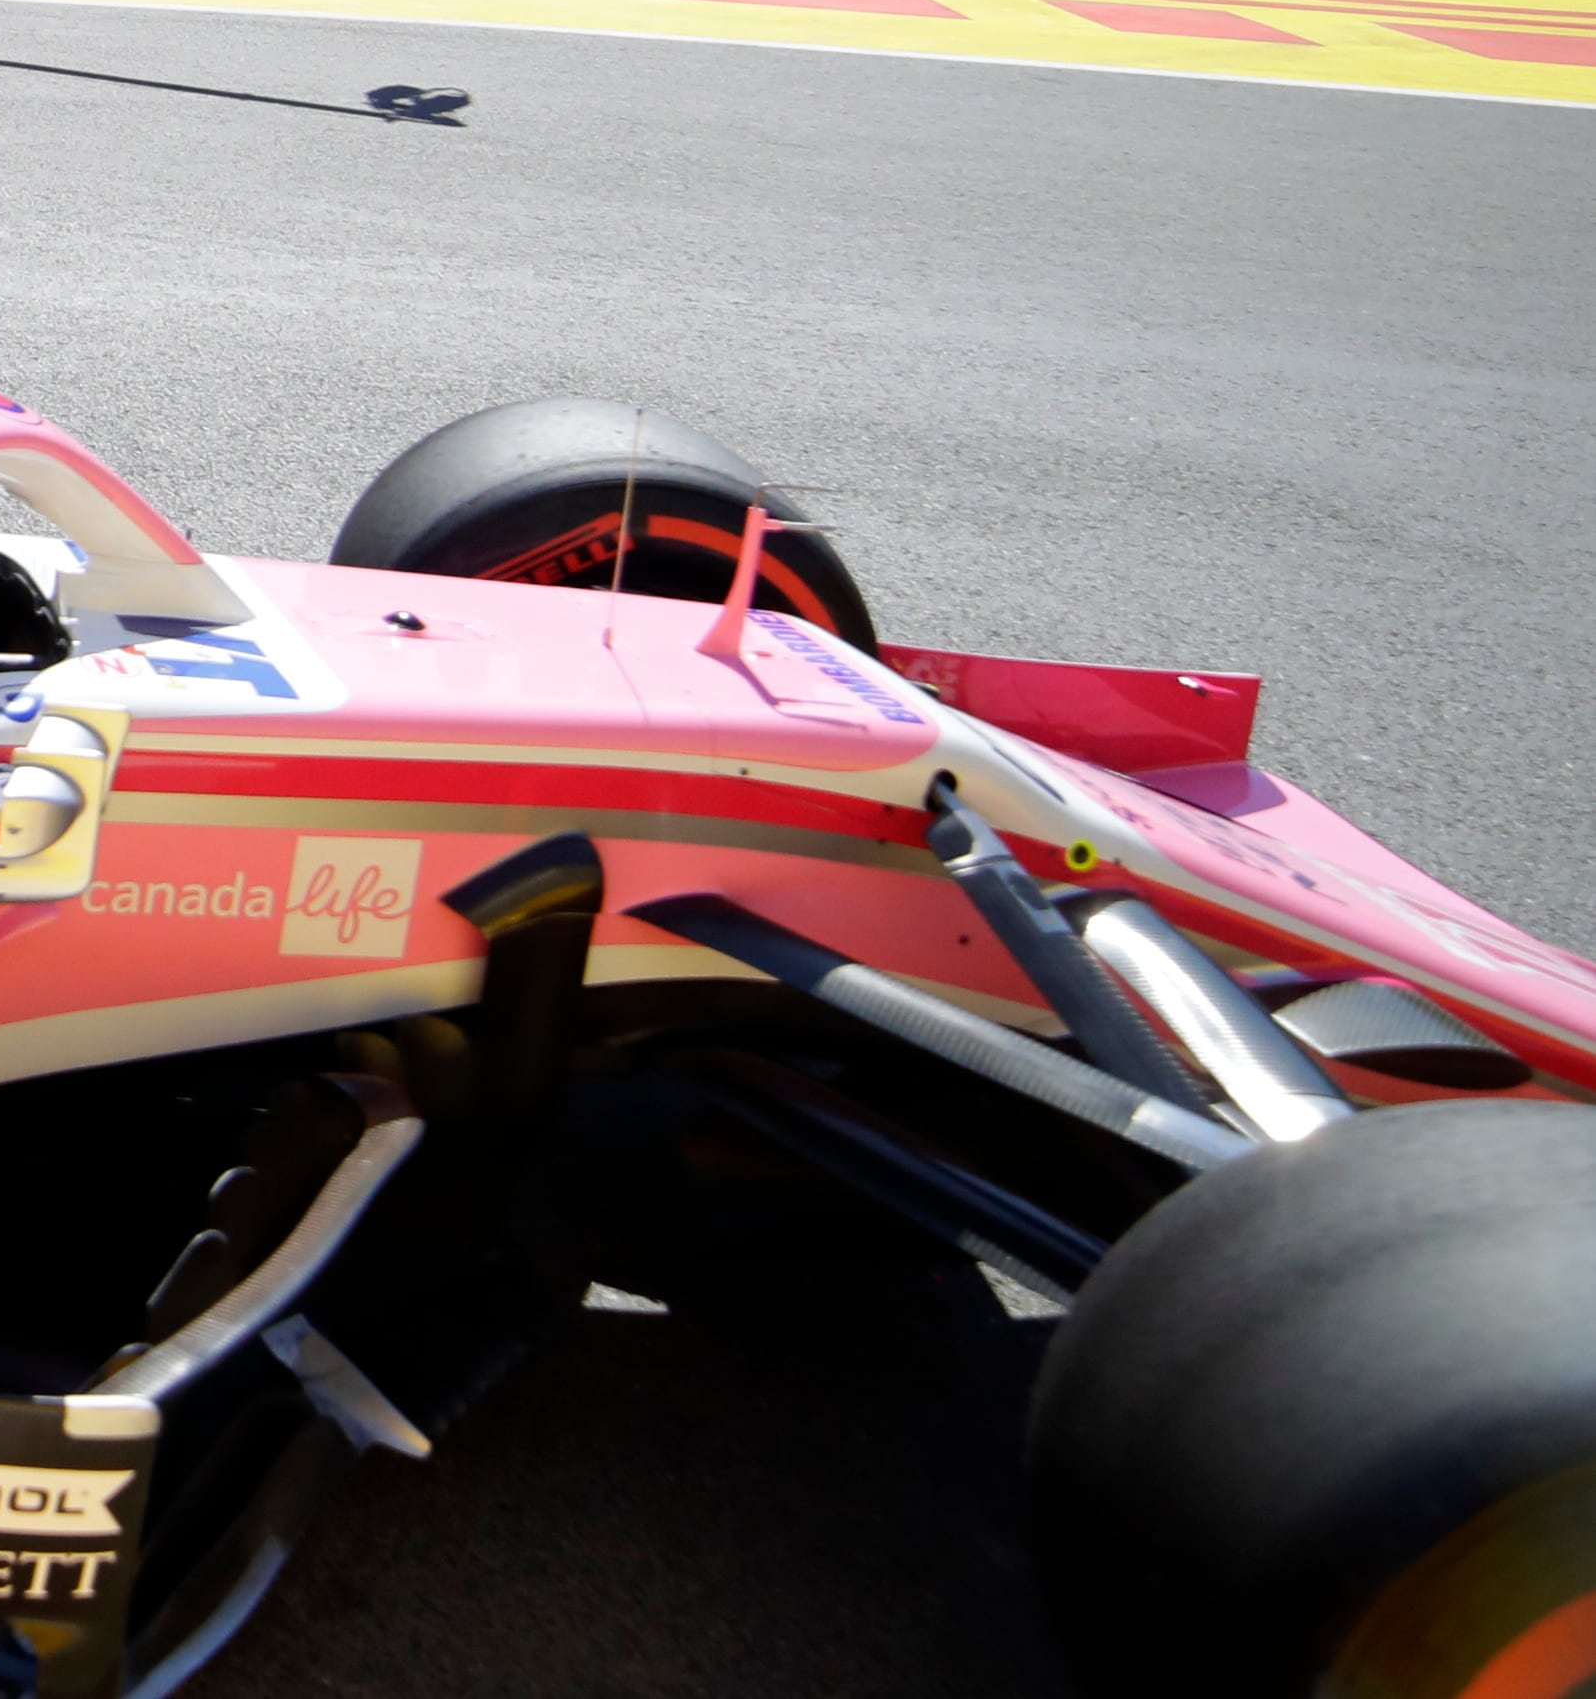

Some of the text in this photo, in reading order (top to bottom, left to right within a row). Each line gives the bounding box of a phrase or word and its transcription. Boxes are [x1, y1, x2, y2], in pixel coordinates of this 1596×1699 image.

[745, 608, 926, 725] BOMBARDIE
[80, 863, 412, 944] canada life
